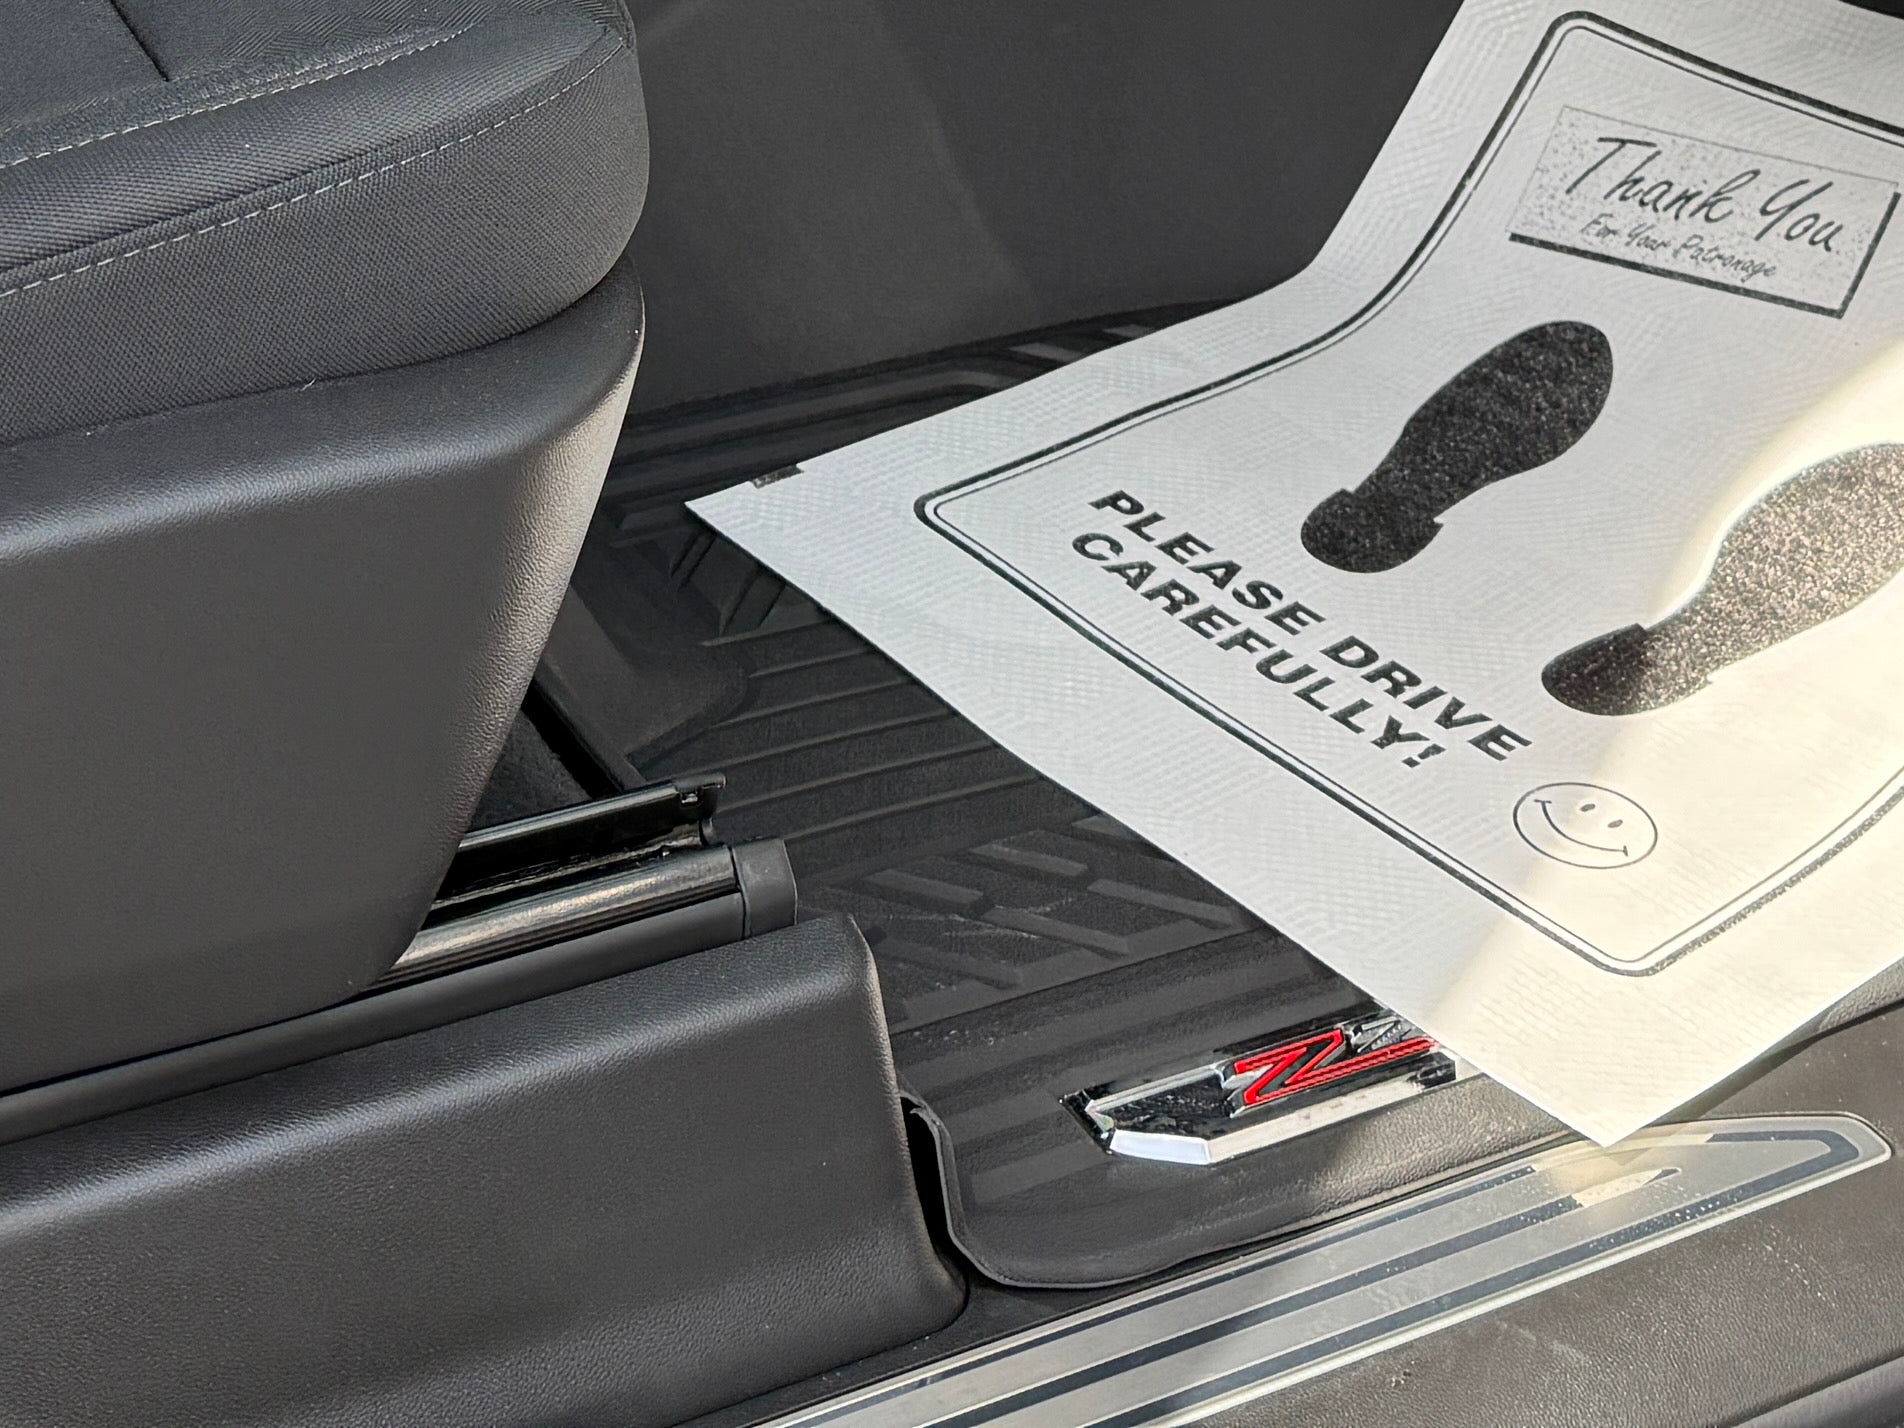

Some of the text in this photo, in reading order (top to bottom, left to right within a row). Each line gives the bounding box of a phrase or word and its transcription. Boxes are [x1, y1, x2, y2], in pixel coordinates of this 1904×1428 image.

[1565, 136, 1846, 253] Thank You
[1580, 212, 1777, 283] For Your Patronage
[1071, 532, 1447, 769] CAREFULLY!
[1089, 489, 1533, 762] PLEASE DRIVE
